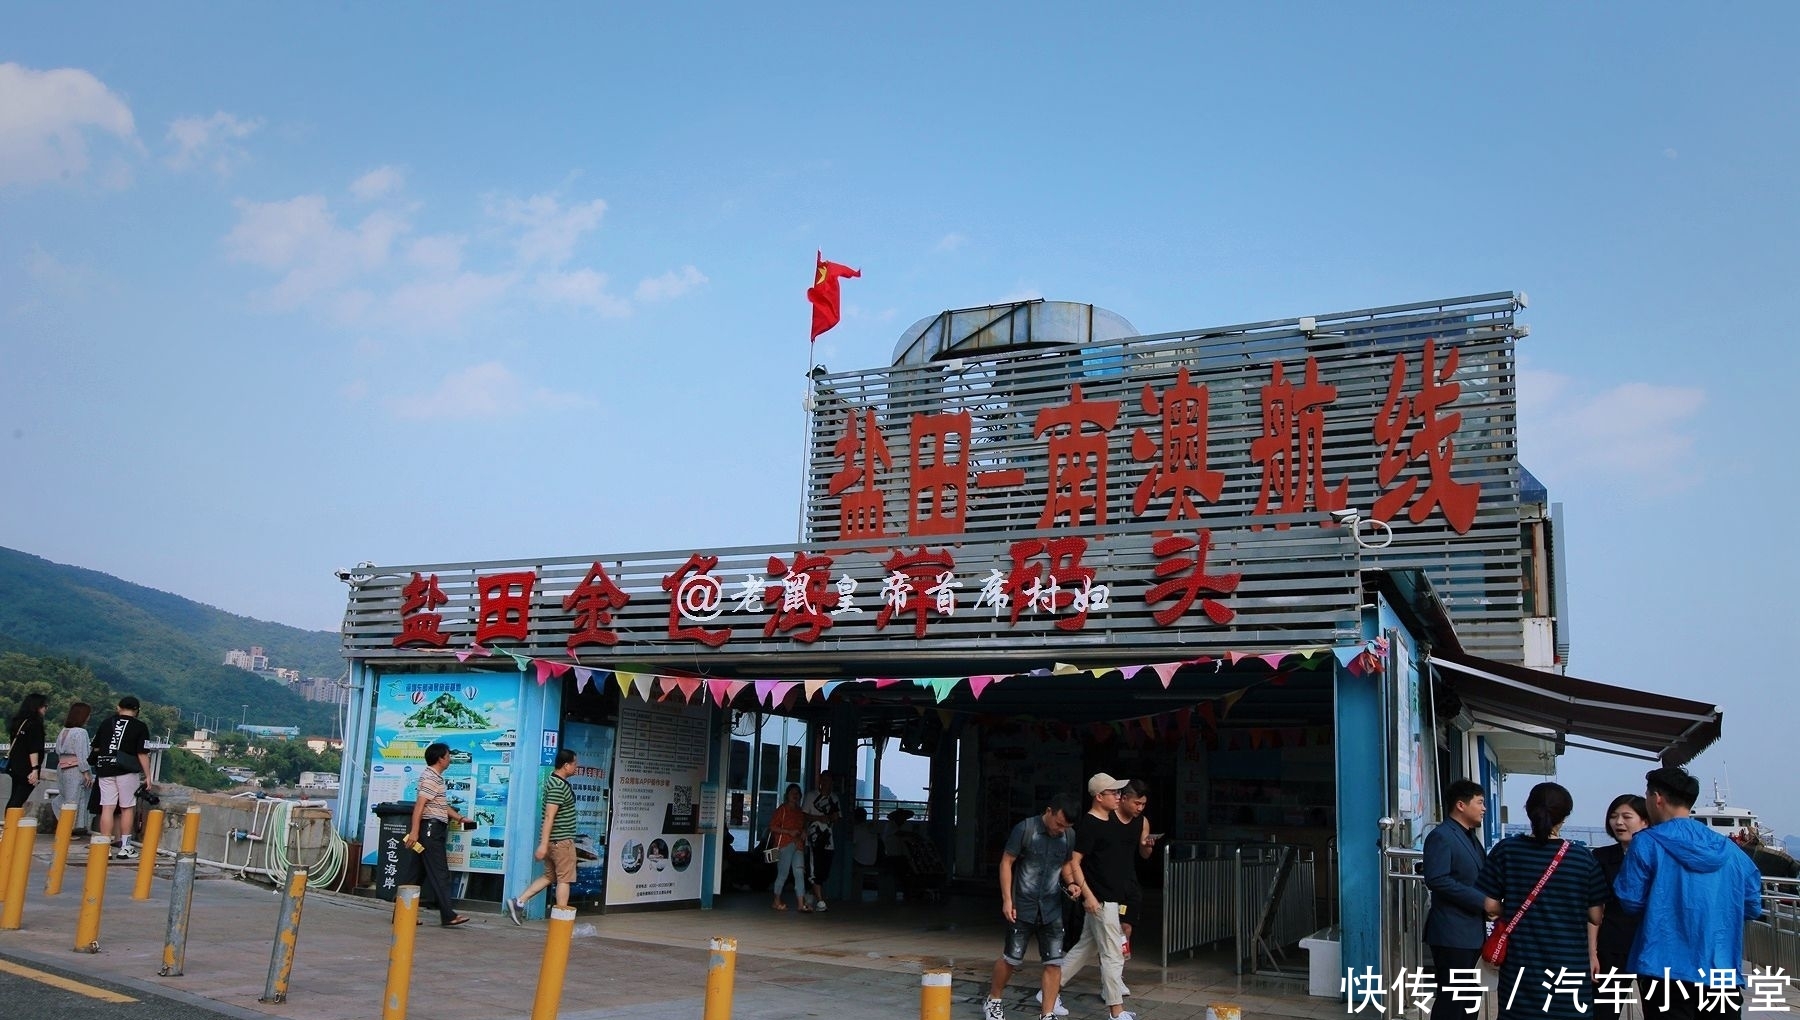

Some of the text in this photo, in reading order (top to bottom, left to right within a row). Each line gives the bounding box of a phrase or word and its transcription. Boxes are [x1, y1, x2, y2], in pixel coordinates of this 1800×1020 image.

[393, 529, 1242, 650] 盐田金色海岸码头
[382, 837, 400, 890] 金色海岸
[1531, 859, 1559, 897] SUPREME
[1505, 899, 1533, 934] SUREME
